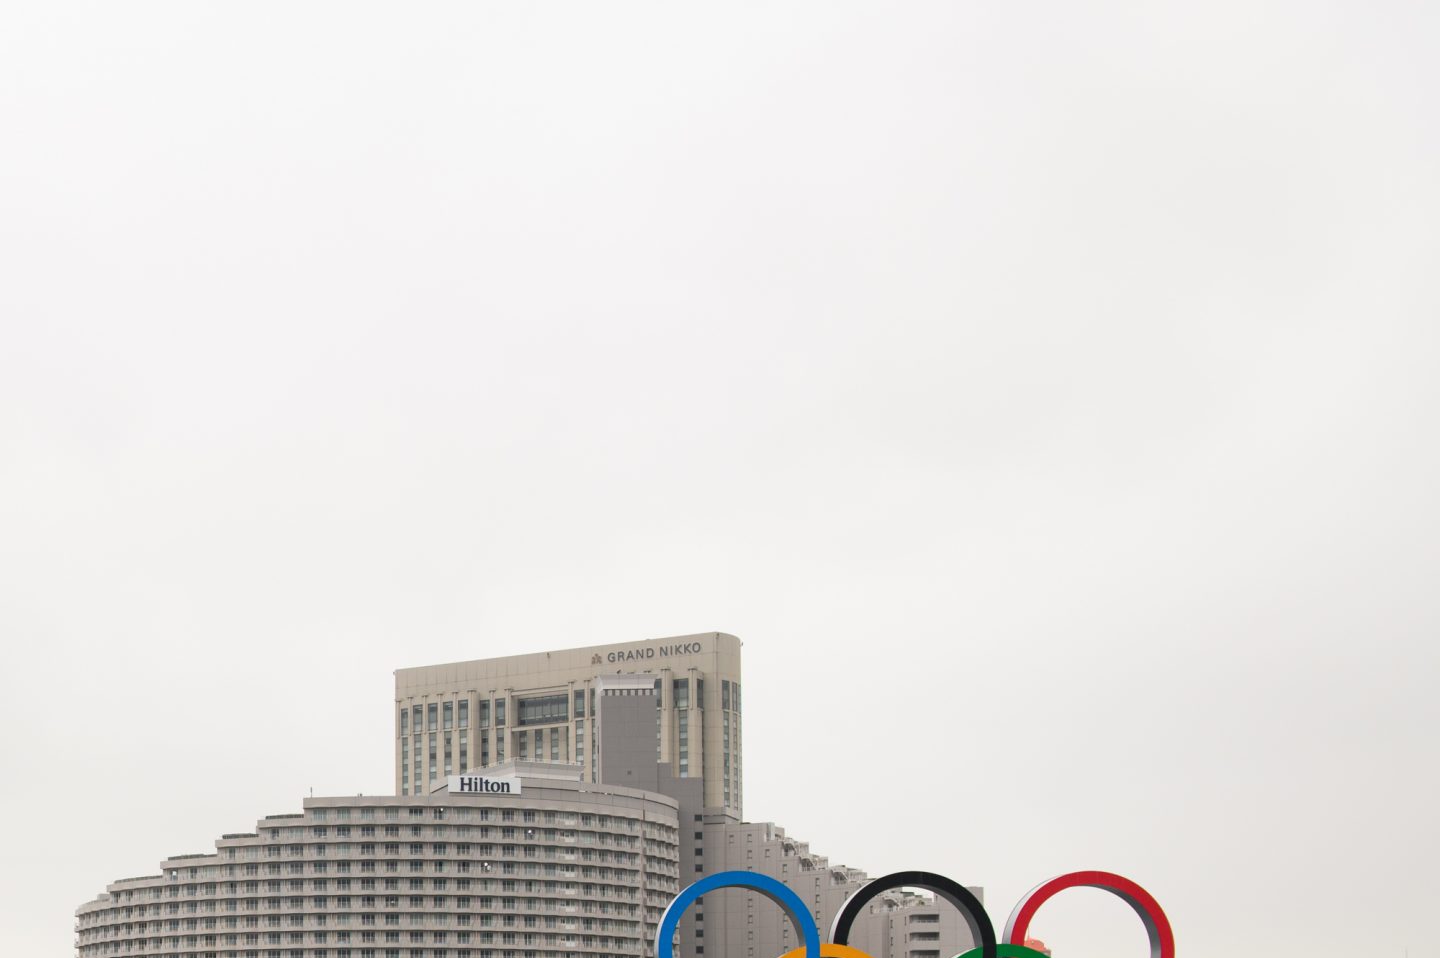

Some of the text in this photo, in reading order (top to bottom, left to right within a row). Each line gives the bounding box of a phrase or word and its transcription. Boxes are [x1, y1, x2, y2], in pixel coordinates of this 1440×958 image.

[607, 642, 702, 663] GRAND NIKKO
[460, 776, 510, 793] Hilton
